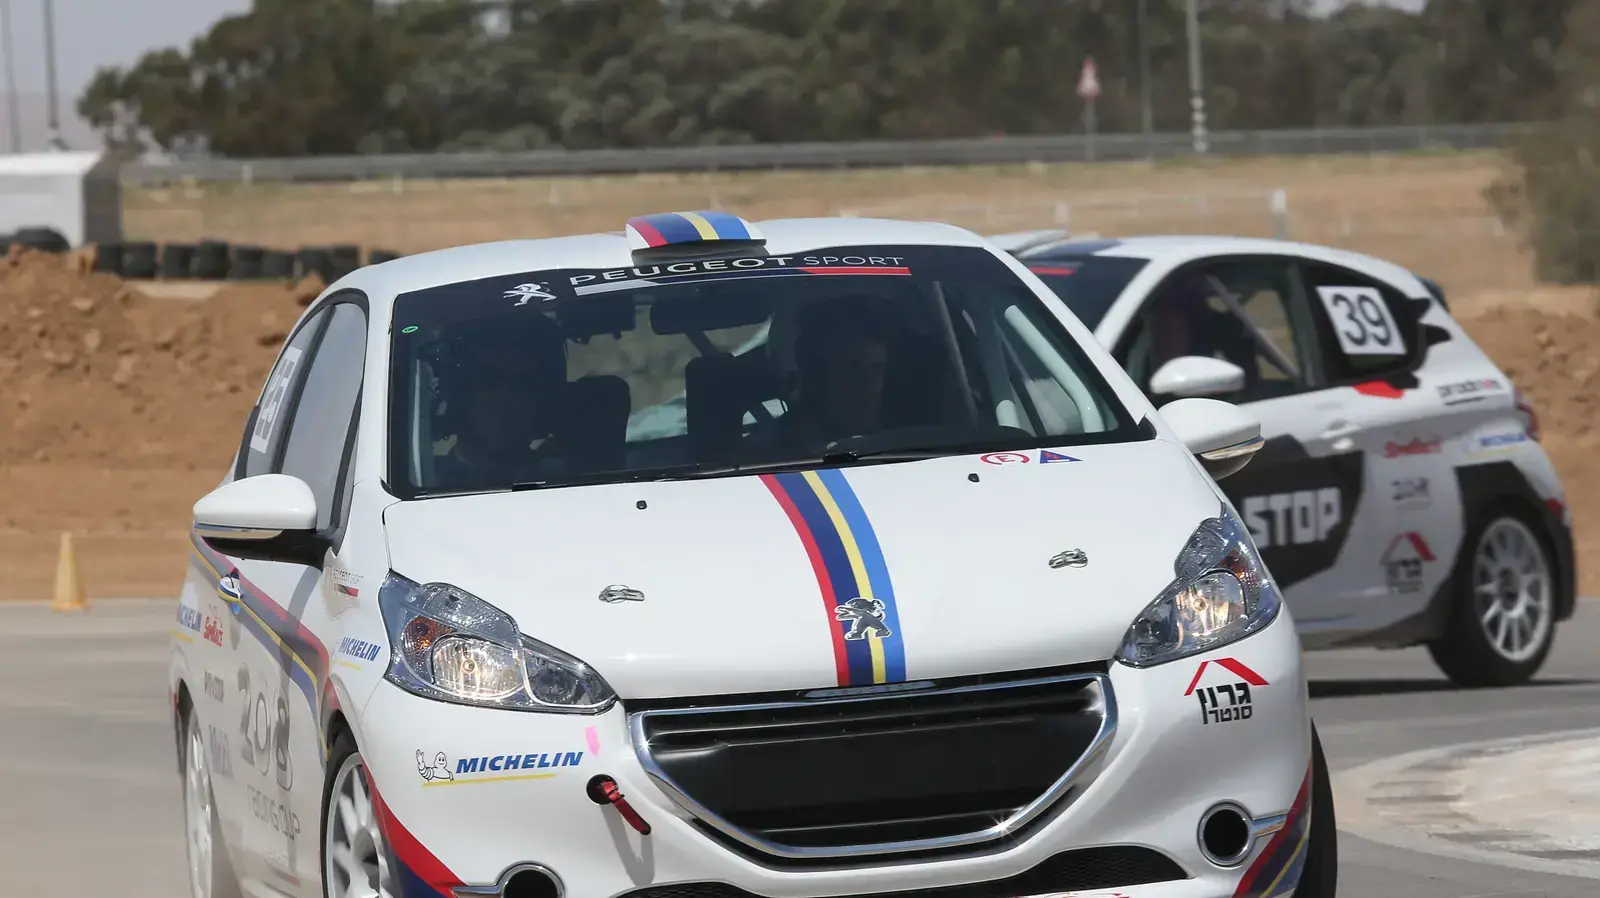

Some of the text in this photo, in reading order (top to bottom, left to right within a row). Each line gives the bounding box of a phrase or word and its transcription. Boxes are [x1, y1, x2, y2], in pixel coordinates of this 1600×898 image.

[569, 255, 904, 286] PEUGEOT SPORT
[1332, 292, 1393, 348] 39
[1243, 486, 1342, 550] STOP
[338, 636, 381, 662] MICHELIN
[1196, 682, 1252, 725] גרון
[1208, 705, 1253, 723] סנטר
[456, 751, 583, 774] MICHELIN
